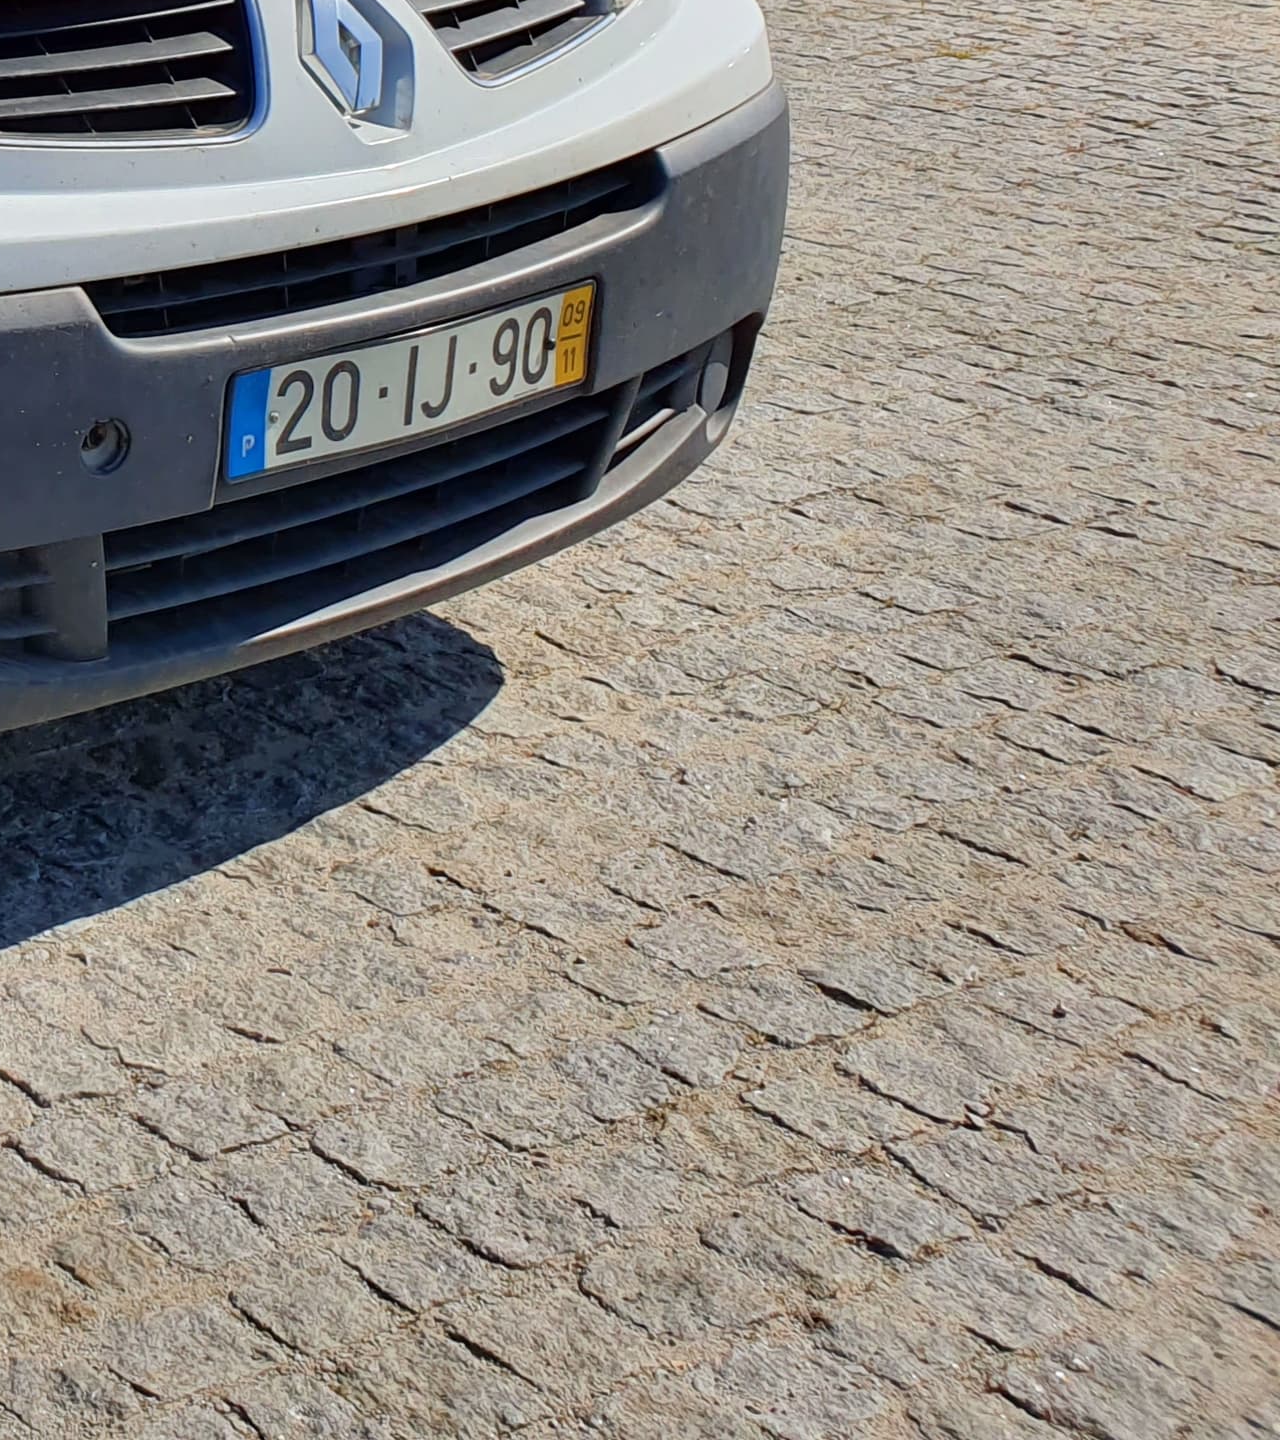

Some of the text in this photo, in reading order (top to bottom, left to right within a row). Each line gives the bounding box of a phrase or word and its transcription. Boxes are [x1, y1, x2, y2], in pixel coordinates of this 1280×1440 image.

[561, 298, 586, 329] 09
[561, 346, 578, 375] 11
[241, 433, 257, 459] P
